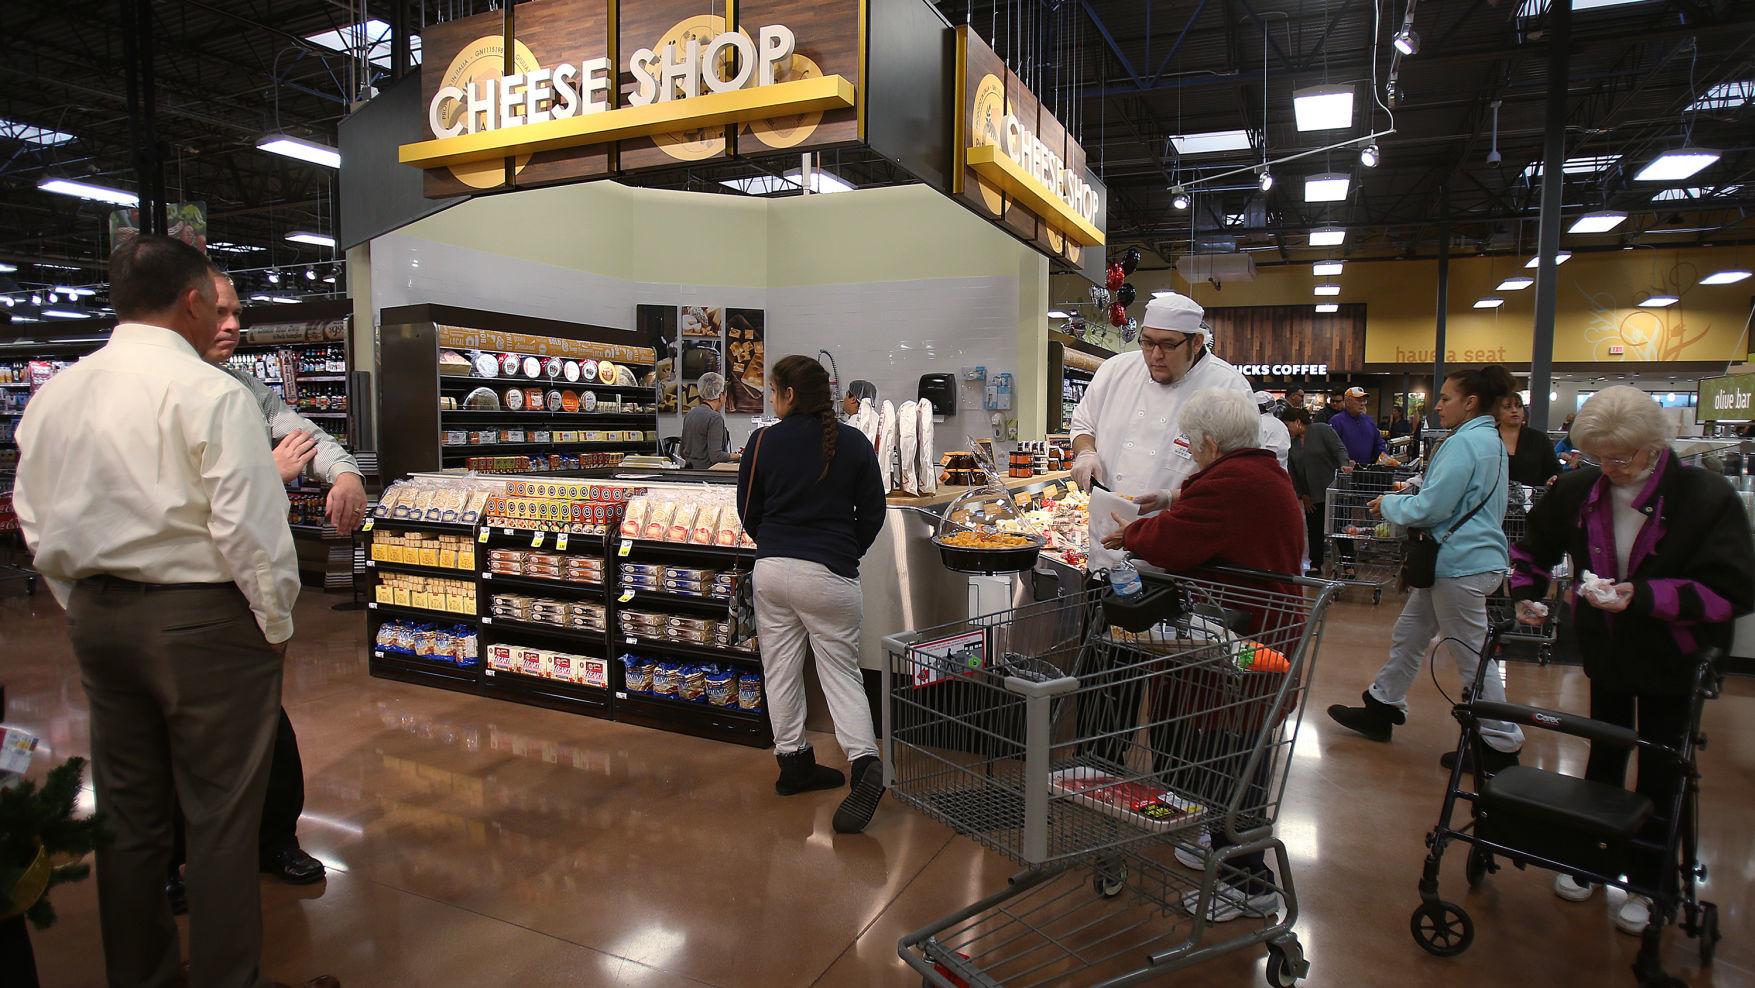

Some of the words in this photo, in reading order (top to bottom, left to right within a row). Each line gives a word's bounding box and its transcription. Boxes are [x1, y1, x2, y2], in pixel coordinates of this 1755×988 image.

[429, 57, 611, 140] CHEESE
[628, 24, 796, 107] SHOP
[1001, 114, 1064, 198] CHEESE
[1063, 168, 1099, 226] SHOP
[1445, 350, 1457, 363] a
[1463, 346, 1507, 362] seat
[1271, 364, 1328, 376] COFFEE
[1714, 389, 1734, 410] olive
[1735, 387, 1752, 409] bar
